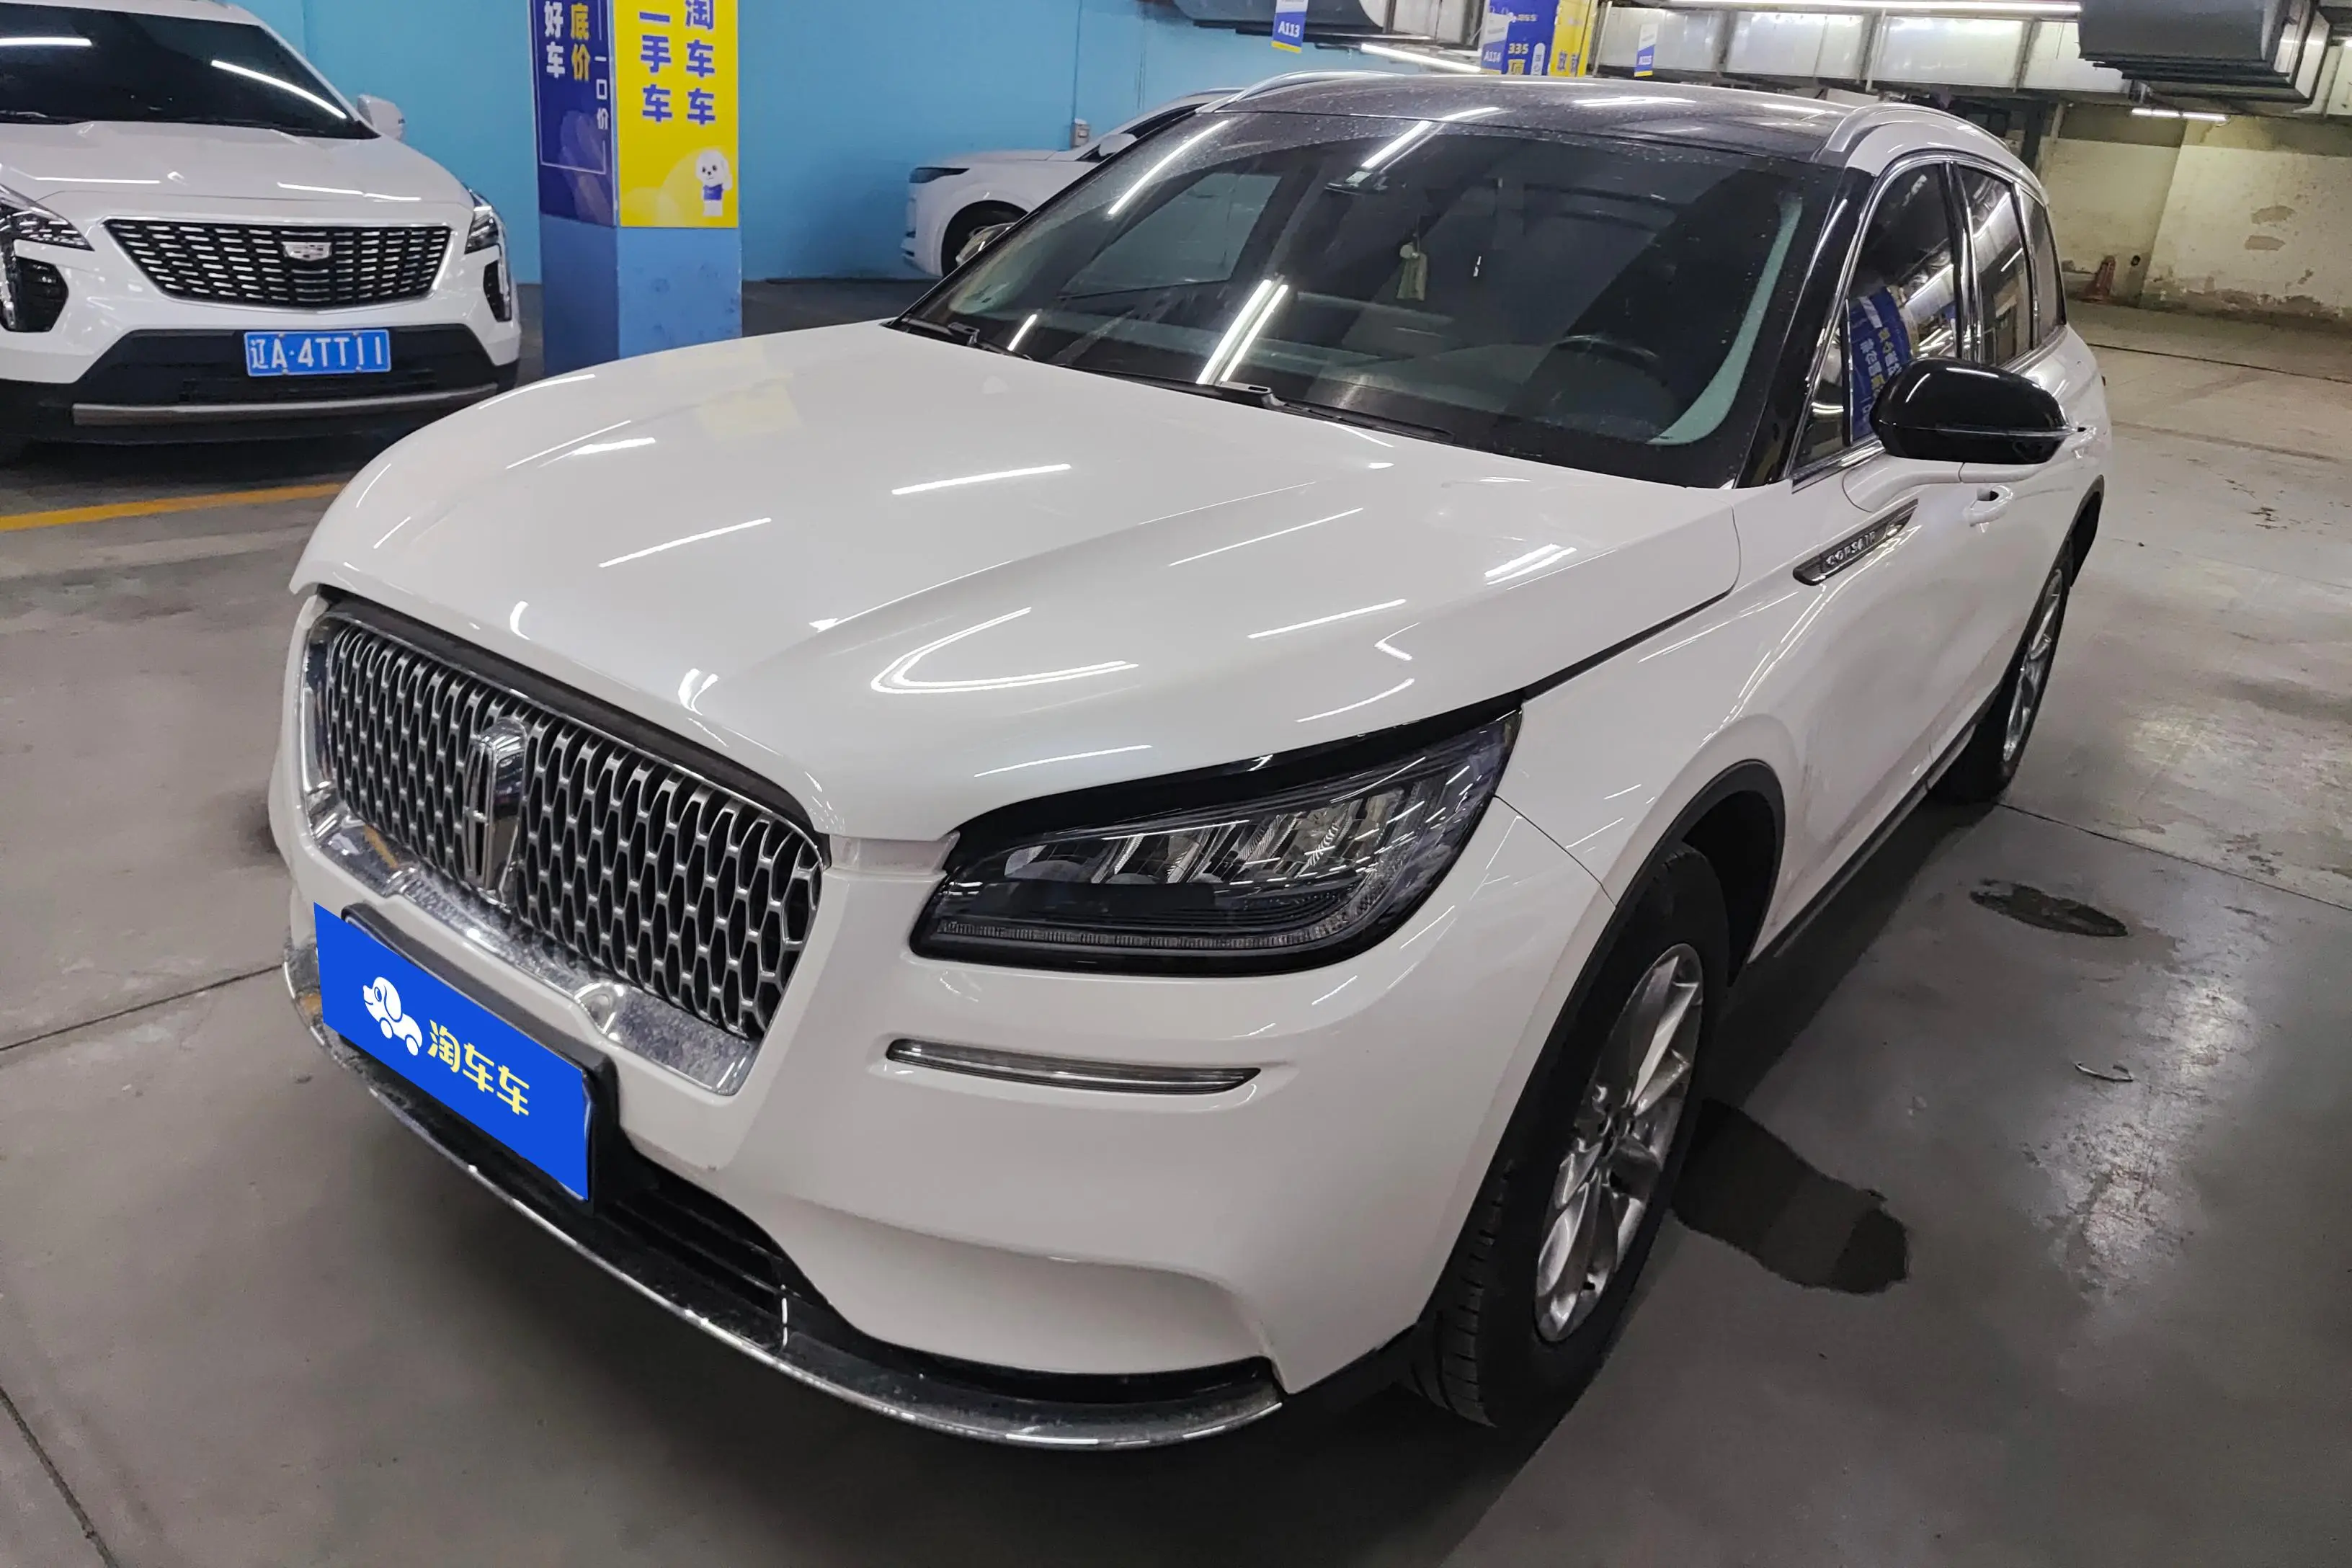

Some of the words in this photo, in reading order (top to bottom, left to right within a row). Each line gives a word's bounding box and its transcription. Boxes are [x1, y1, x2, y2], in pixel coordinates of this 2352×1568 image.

[543, 1, 566, 79] 好车
[570, 3, 591, 81] 底价
[685, 0, 716, 125] 淘车车
[1278, 20, 1301, 38] A113
[1508, 43, 1530, 55] 335
[594, 55, 610, 130] 一口价
